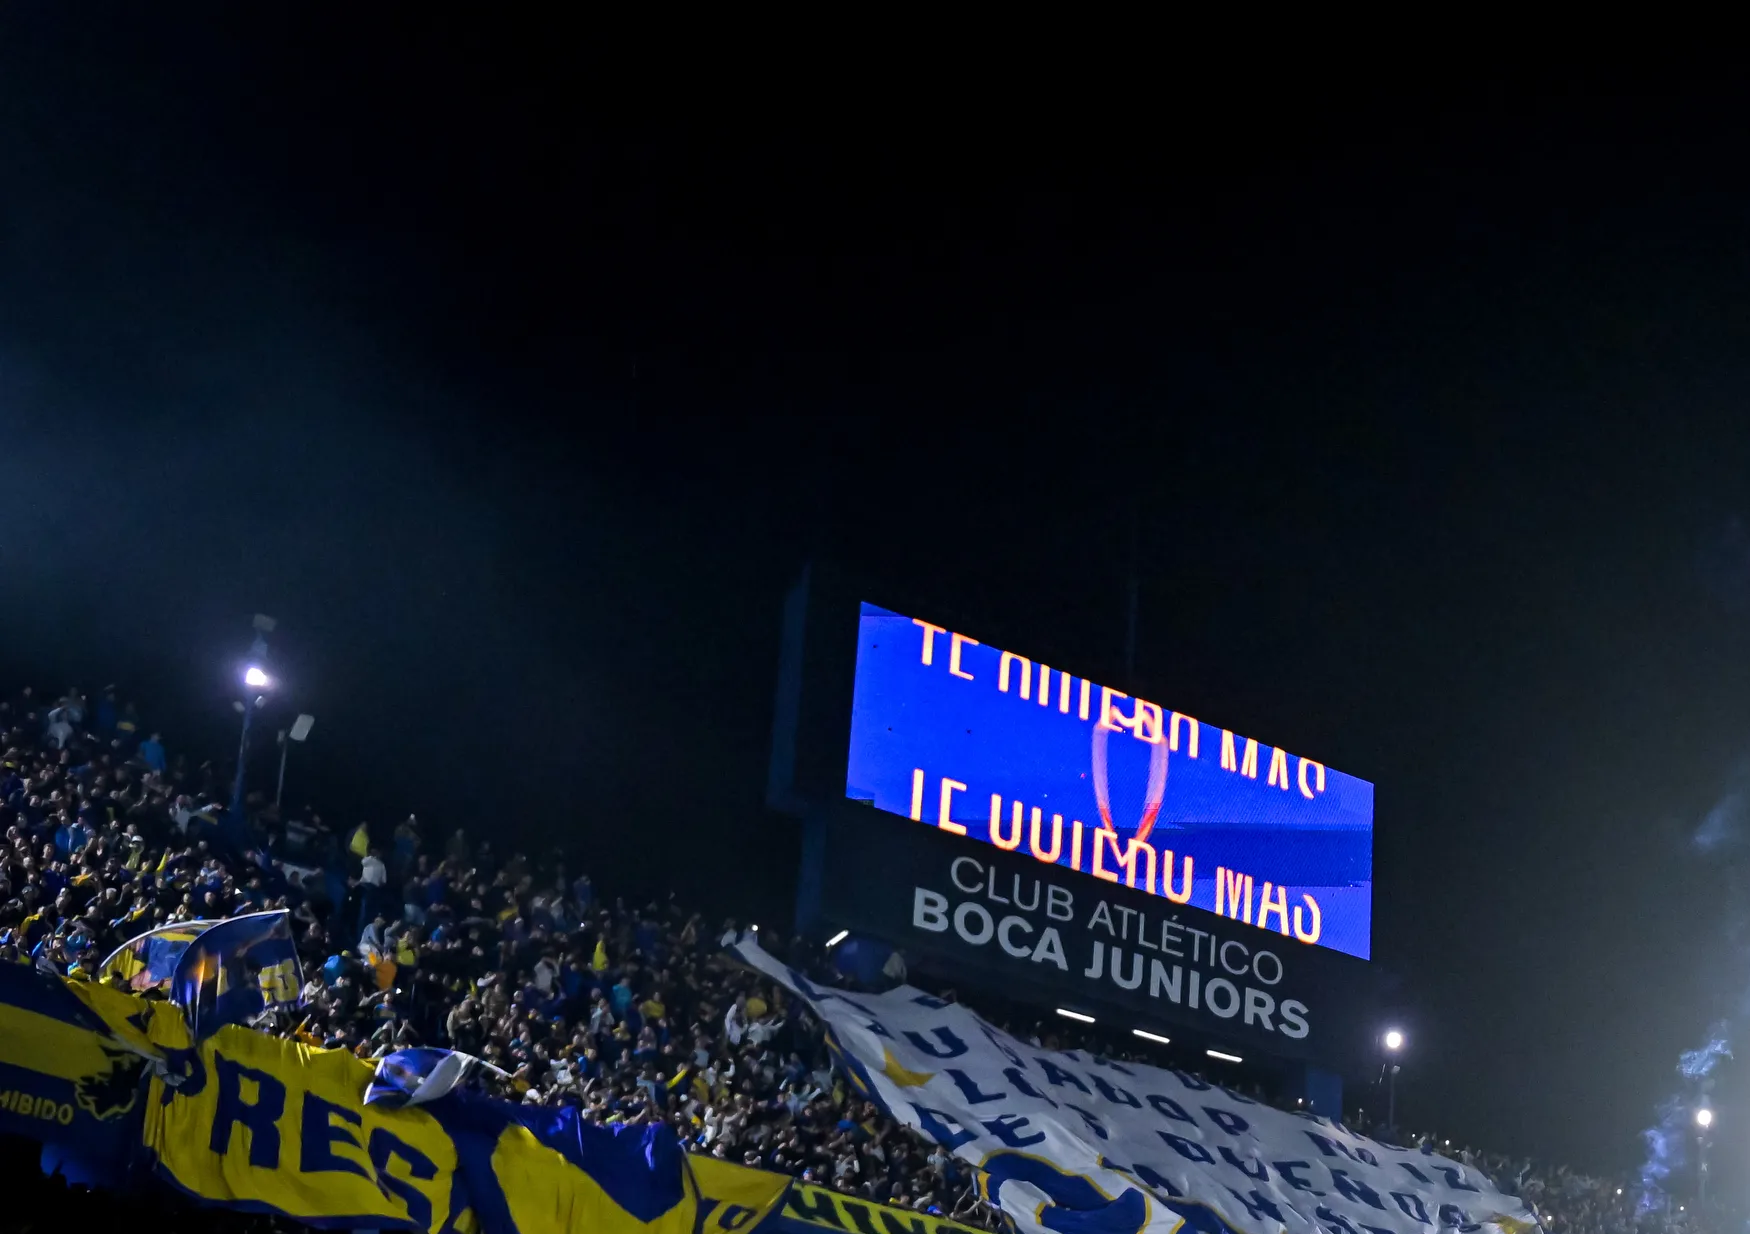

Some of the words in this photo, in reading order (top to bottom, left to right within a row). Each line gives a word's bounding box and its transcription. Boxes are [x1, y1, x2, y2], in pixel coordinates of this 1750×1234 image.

[912, 887, 1069, 971] BOCA
[1084, 939, 1311, 1040] JUNIORS
[951, 856, 1075, 922] CLUB
[1088, 900, 1284, 985] ATLÉTICO
